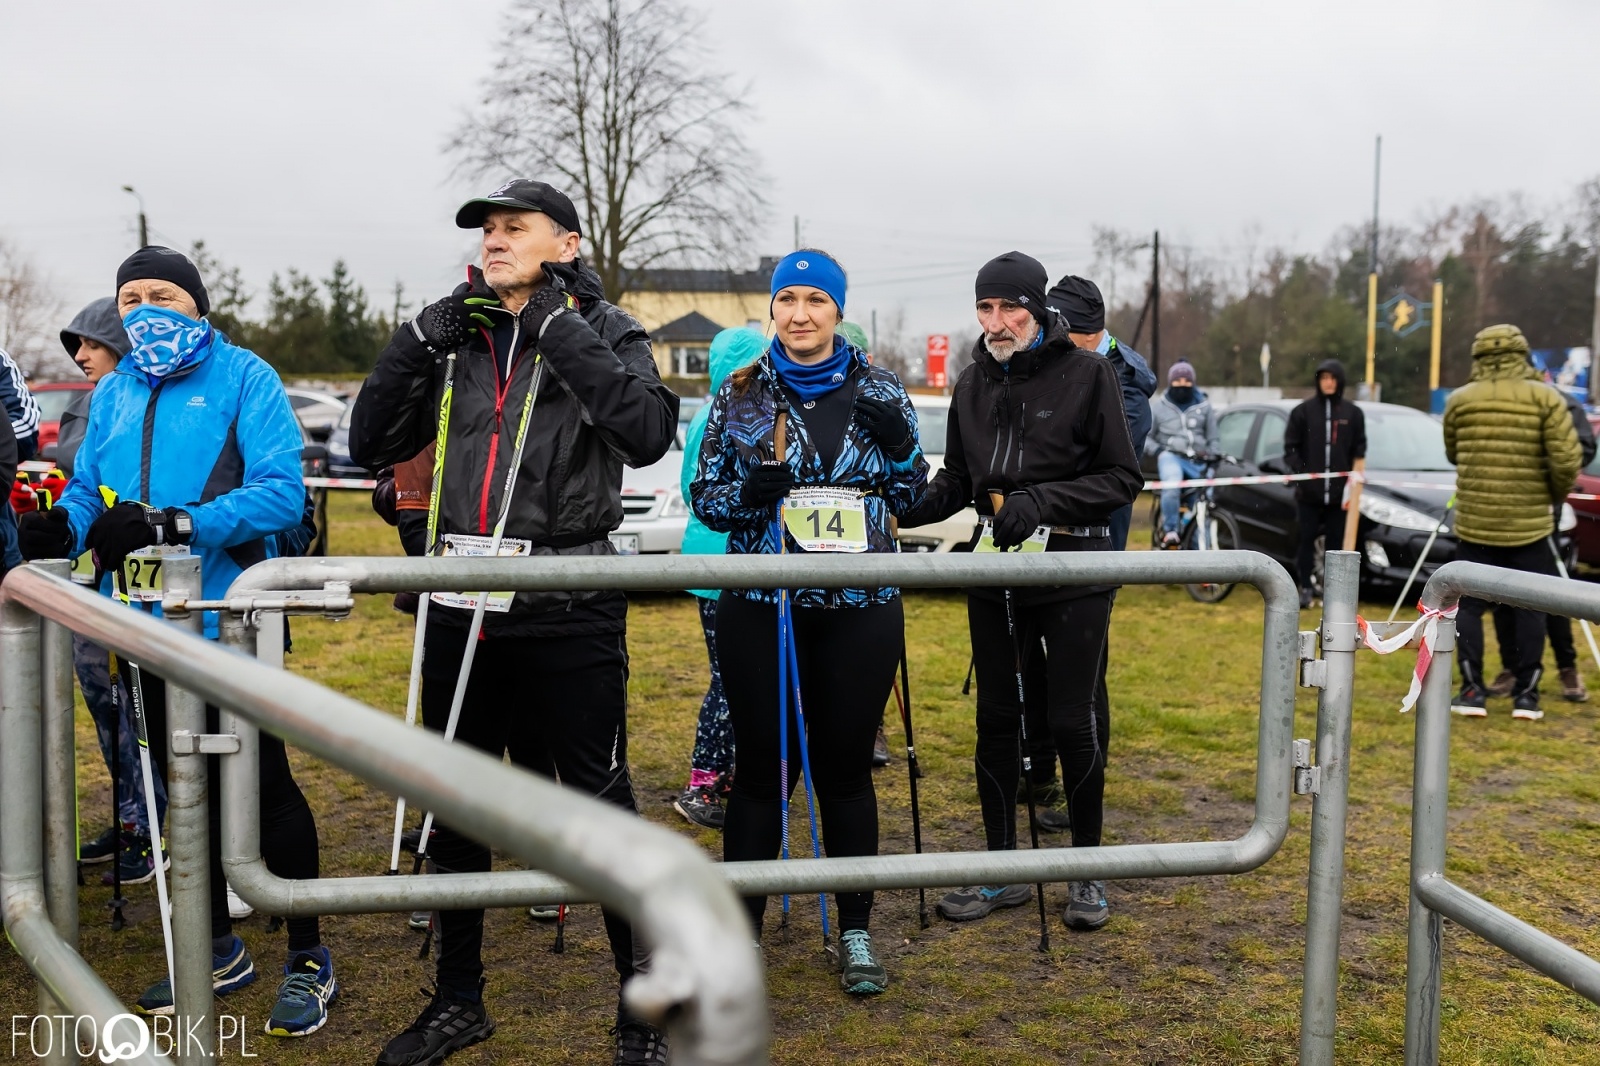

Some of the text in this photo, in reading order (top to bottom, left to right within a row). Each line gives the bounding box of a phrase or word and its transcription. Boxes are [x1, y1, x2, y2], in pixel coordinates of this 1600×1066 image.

[1018, 295, 1030, 304] 4F
[1036, 410, 1053, 418] 4F
[435, 404, 448, 463] FIZAN
[806, 509, 845, 538] 14
[129, 558, 162, 588] 27
[133, 686, 141, 719] CARBON
